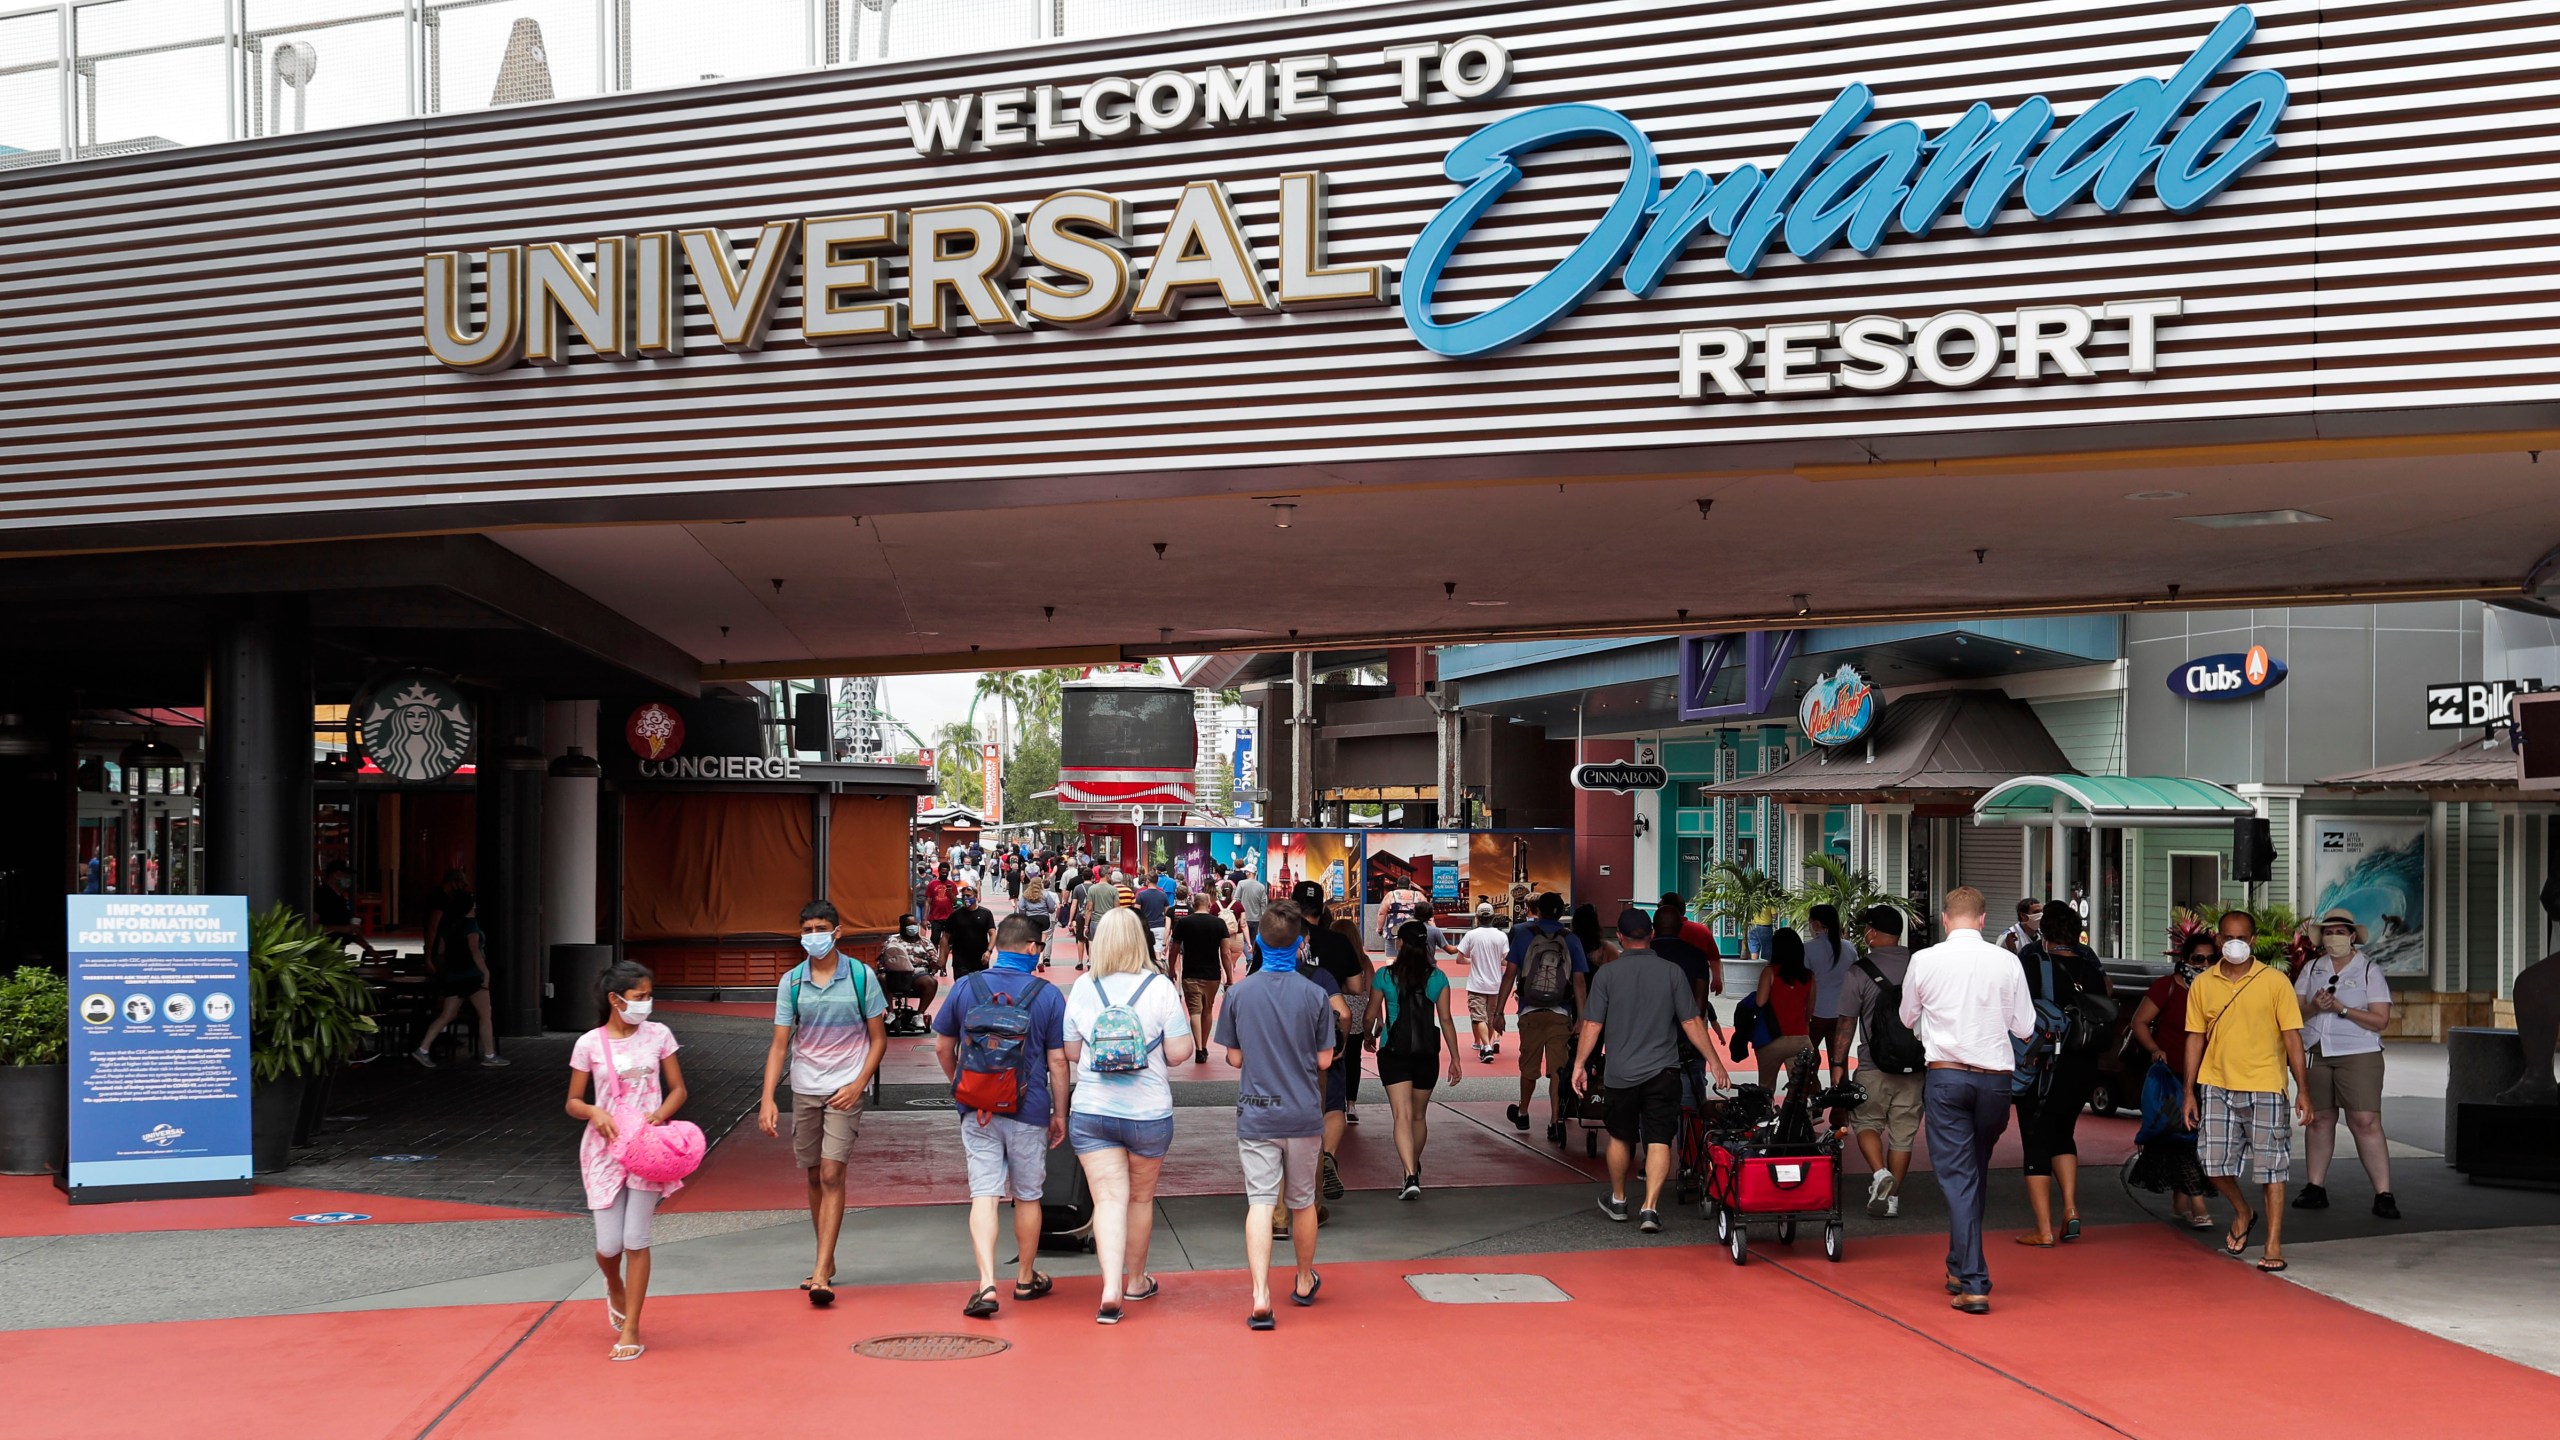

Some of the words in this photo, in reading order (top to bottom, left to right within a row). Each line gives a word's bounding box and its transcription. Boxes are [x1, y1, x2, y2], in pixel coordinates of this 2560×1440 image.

[902, 54, 1335, 156] WELCOME
[1383, 34, 1513, 105] TO
[423, 170, 1391, 372] UNIVERSAL
[1400, 4, 2289, 360] Orlando
[1678, 296, 2184, 400] RESORT
[2186, 664, 2242, 693] Clubs
[640, 756, 800, 778] CONCIERGE
[1242, 751, 1252, 791] DANC
[1584, 770, 1662, 784] CINNABON
[106, 904, 209, 916] IMPORTANT
[96, 918, 220, 930] INFORMATION
[79, 931, 114, 944] FOR
[118, 931, 191, 943] TODAY'S
[195, 931, 237, 943] VISIT
[142, 1128, 185, 1140] UNIVERSAL
